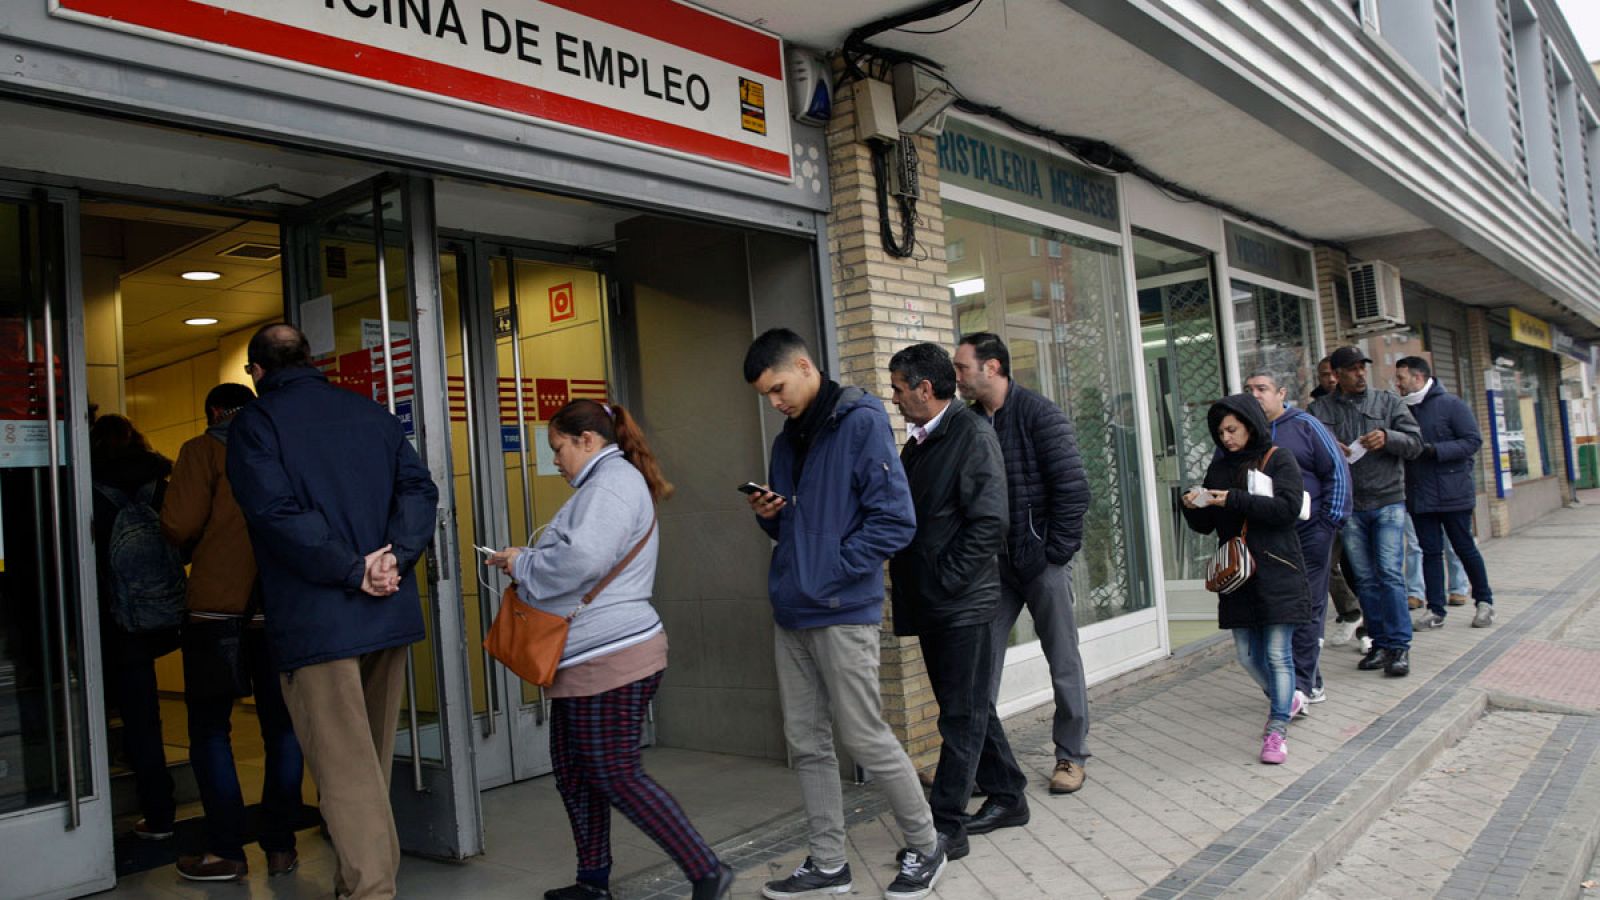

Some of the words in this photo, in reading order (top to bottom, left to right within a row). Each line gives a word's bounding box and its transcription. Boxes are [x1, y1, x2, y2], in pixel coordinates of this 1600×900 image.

[325, 0, 467, 45] INA
[482, 9, 542, 65] DE
[556, 32, 710, 111] EMPLEO
[1049, 166, 1117, 221] MENESES
